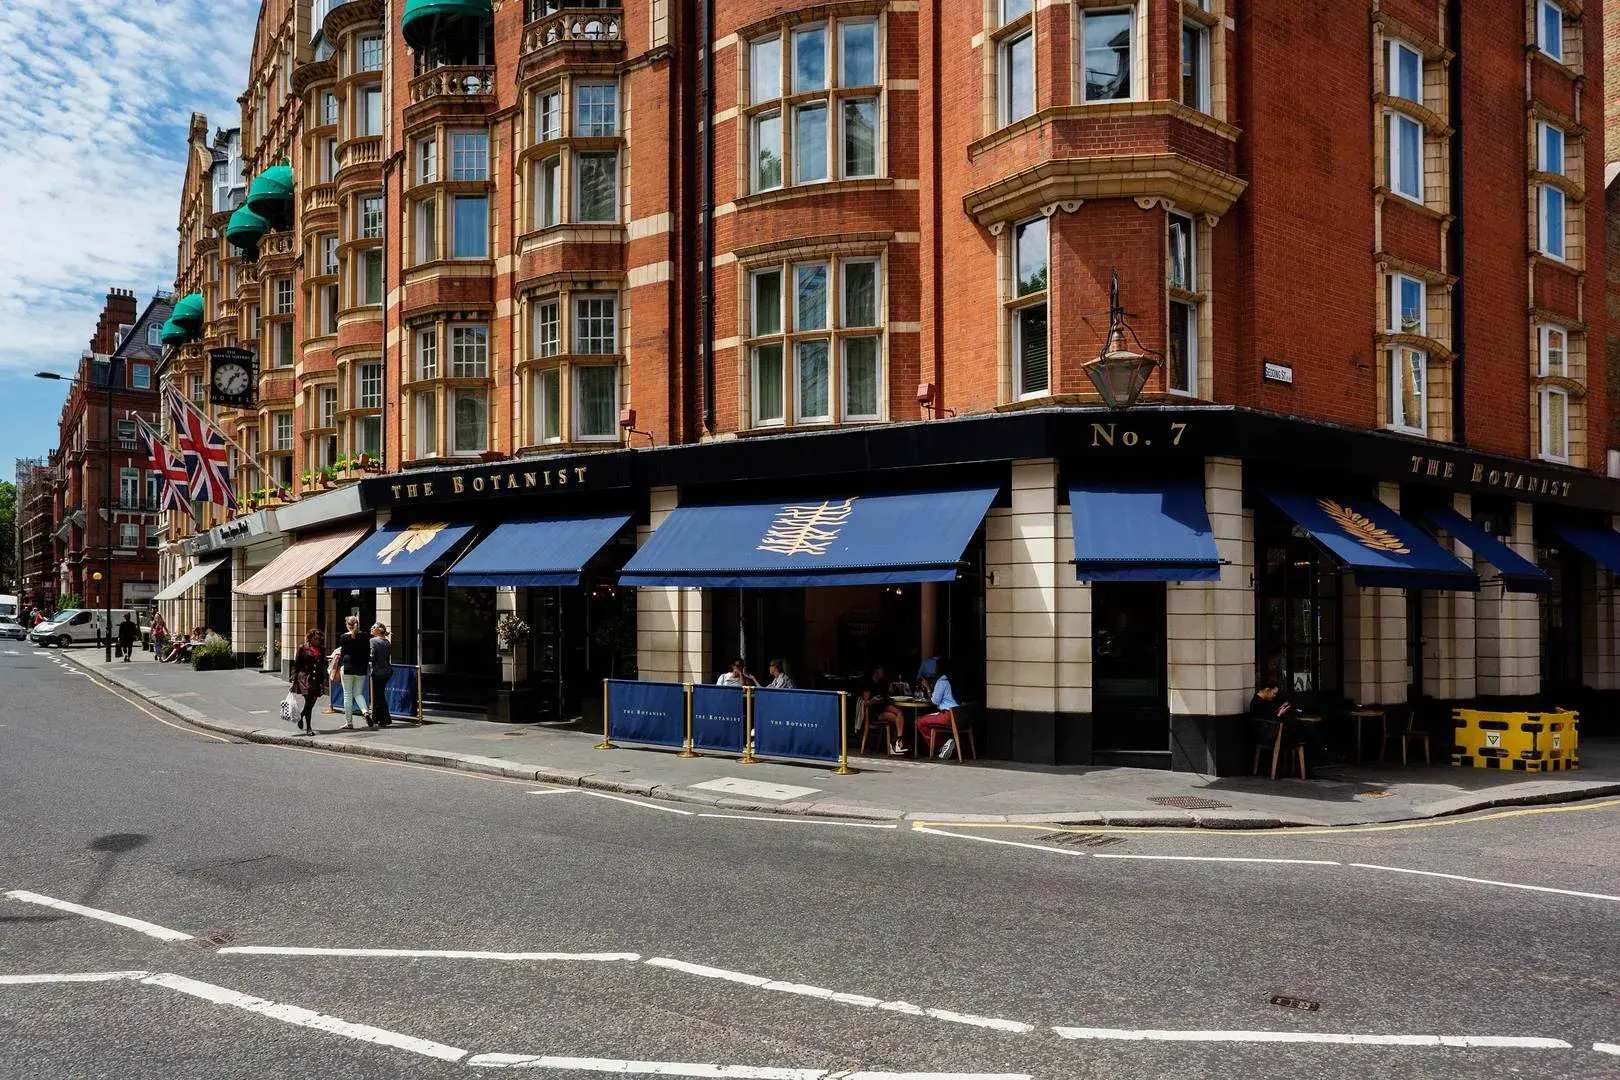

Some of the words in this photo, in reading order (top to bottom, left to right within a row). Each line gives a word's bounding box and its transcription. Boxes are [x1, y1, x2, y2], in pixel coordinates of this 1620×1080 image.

[1091, 423, 1151, 447] No.
[1170, 422, 1188, 446] 7
[391, 481, 434, 499] THE
[452, 467, 587, 493] BOTANIST
[1411, 455, 1455, 478] THE
[1470, 463, 1572, 497] BOTANIST
